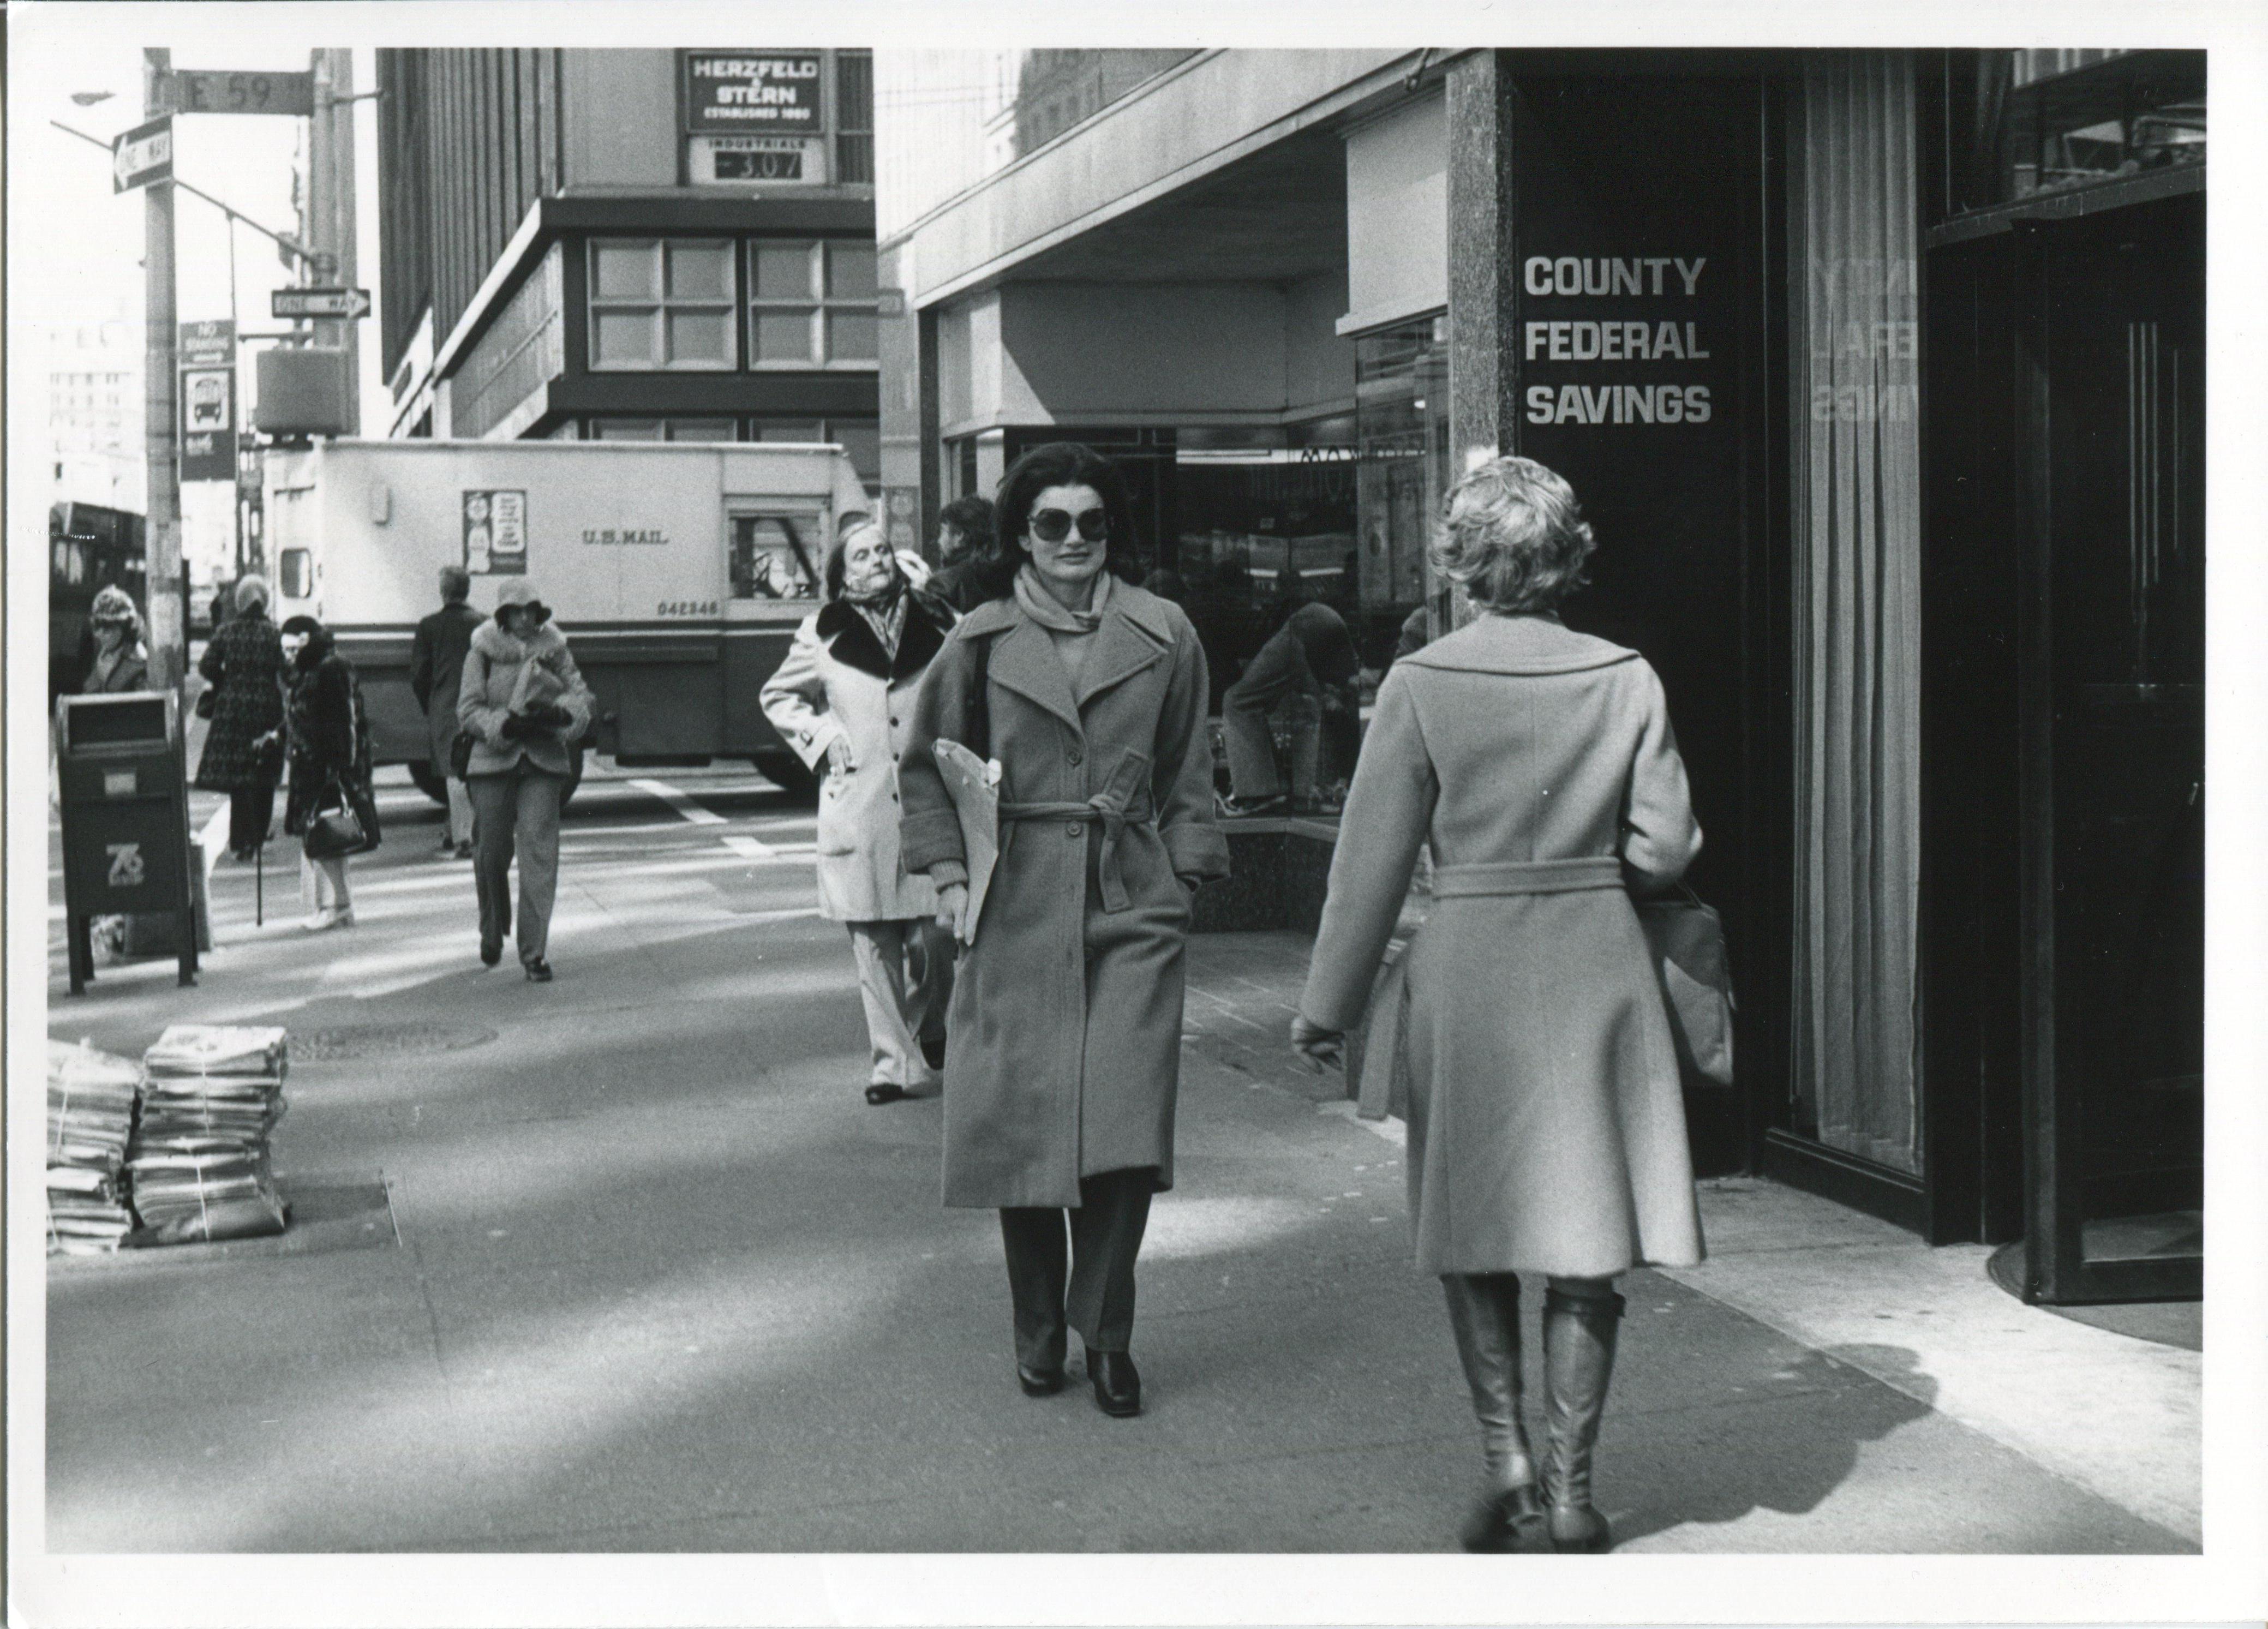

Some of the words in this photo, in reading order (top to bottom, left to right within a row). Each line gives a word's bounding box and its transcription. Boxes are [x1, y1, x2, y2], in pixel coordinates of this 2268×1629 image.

[693, 59, 818, 77] HERZFELD
[191, 75, 209, 110] E
[229, 73, 272, 109] 59
[716, 86, 797, 104] STERN
[709, 139, 807, 149] INDUSTRIALS
[1524, 256, 1707, 296] COUNTY
[1525, 321, 1710, 360] FEDERAL
[1527, 385, 1712, 424] SAVINGS
